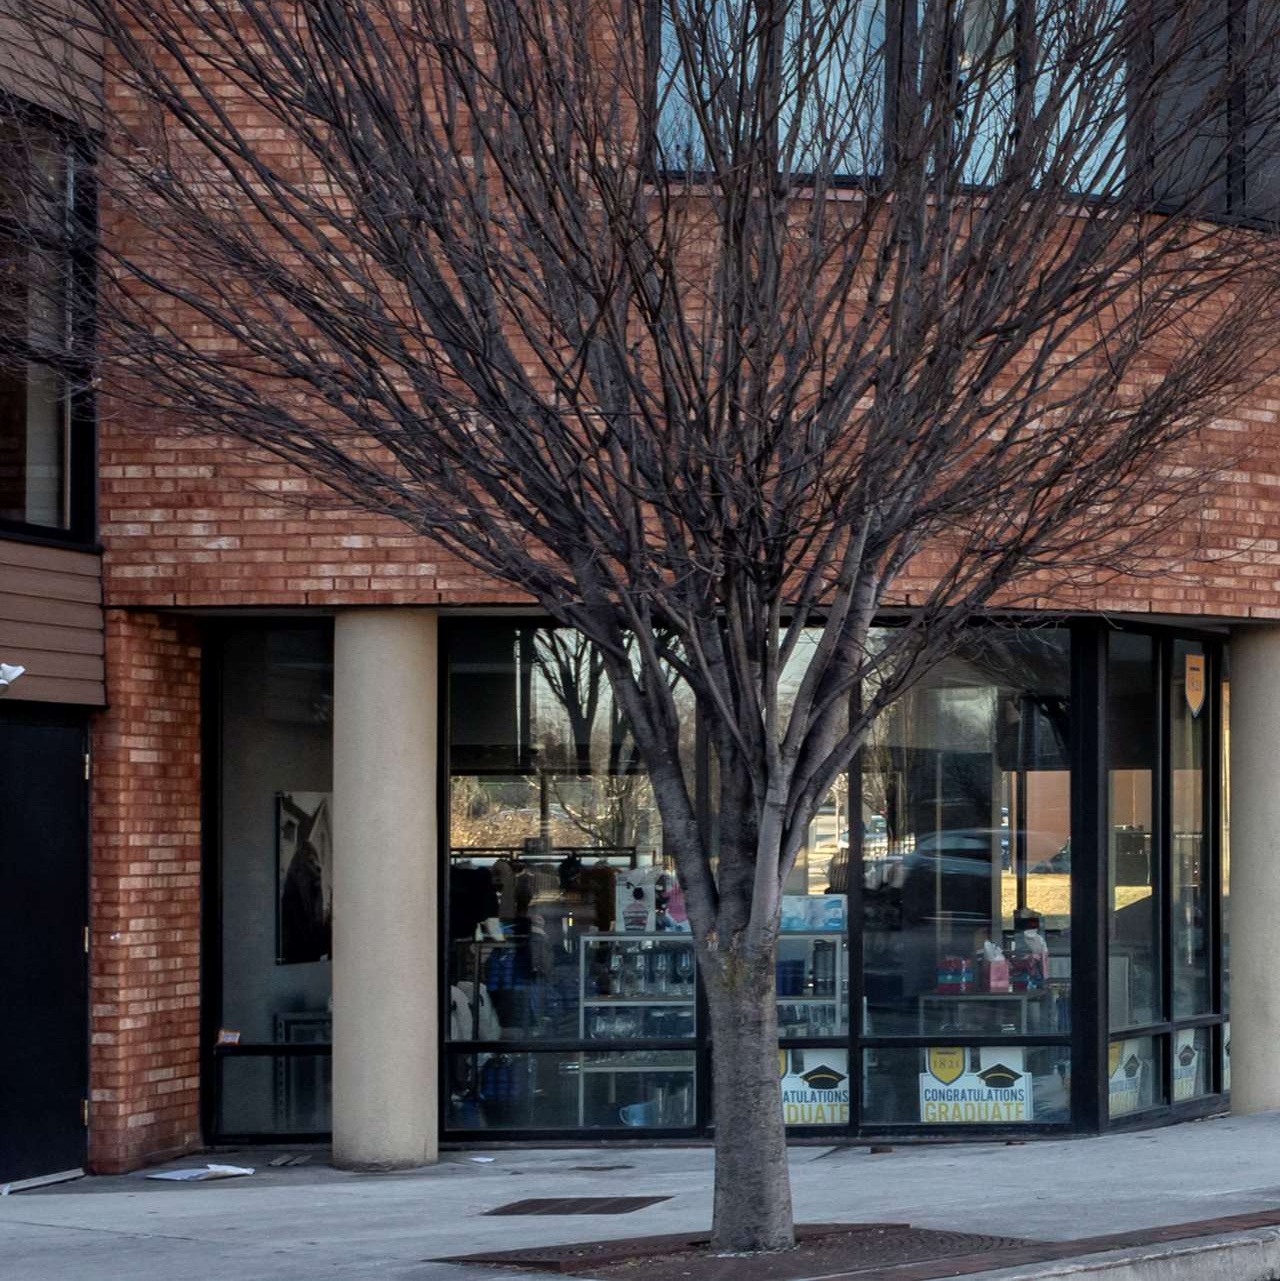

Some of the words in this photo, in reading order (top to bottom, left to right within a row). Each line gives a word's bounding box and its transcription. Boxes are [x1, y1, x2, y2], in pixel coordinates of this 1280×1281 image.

[783, 1089, 849, 1103] ATULATIONS
[924, 1088, 1025, 1102] CONGRATULATIONS
[785, 1103, 849, 1124] DUATE
[925, 1102, 1025, 1122] GRADUATE
